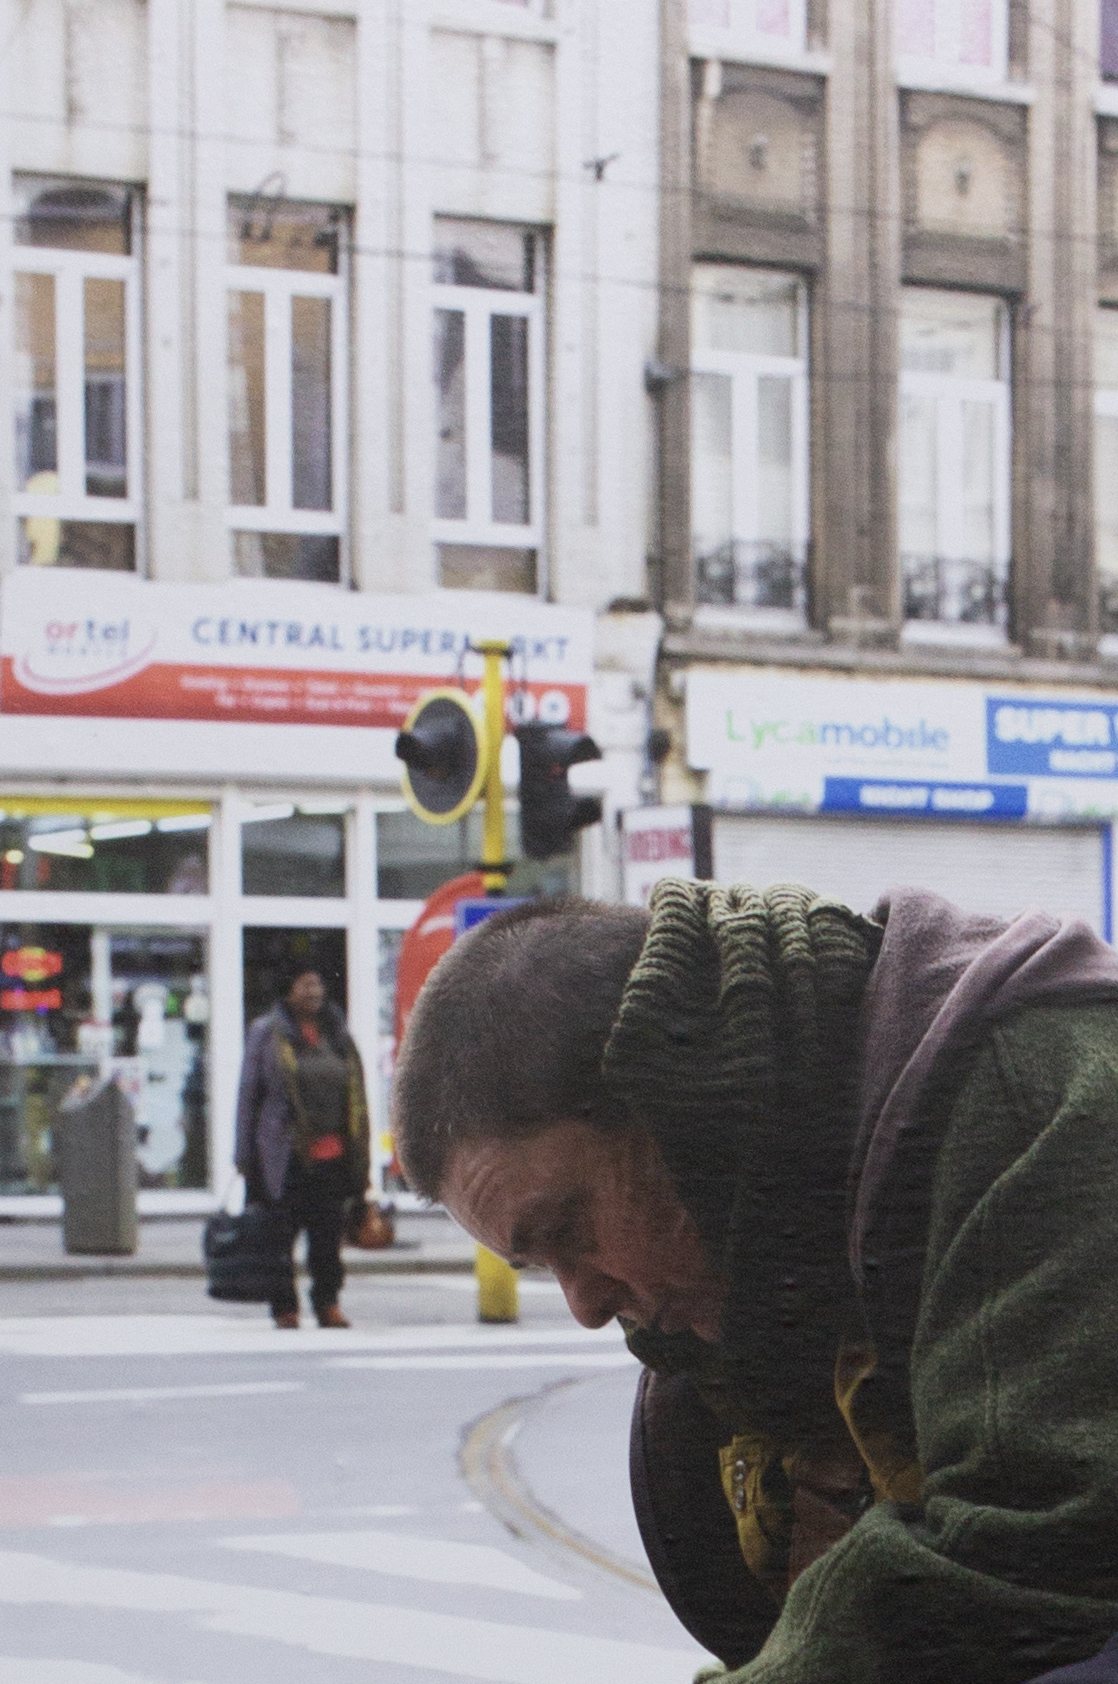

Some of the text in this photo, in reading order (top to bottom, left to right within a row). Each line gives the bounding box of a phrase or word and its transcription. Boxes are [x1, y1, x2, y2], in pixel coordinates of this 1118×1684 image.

[192, 616, 342, 650] CENTRAL
[725, 708, 951, 752] Lycamobile
[995, 706, 1111, 746] SUPER
